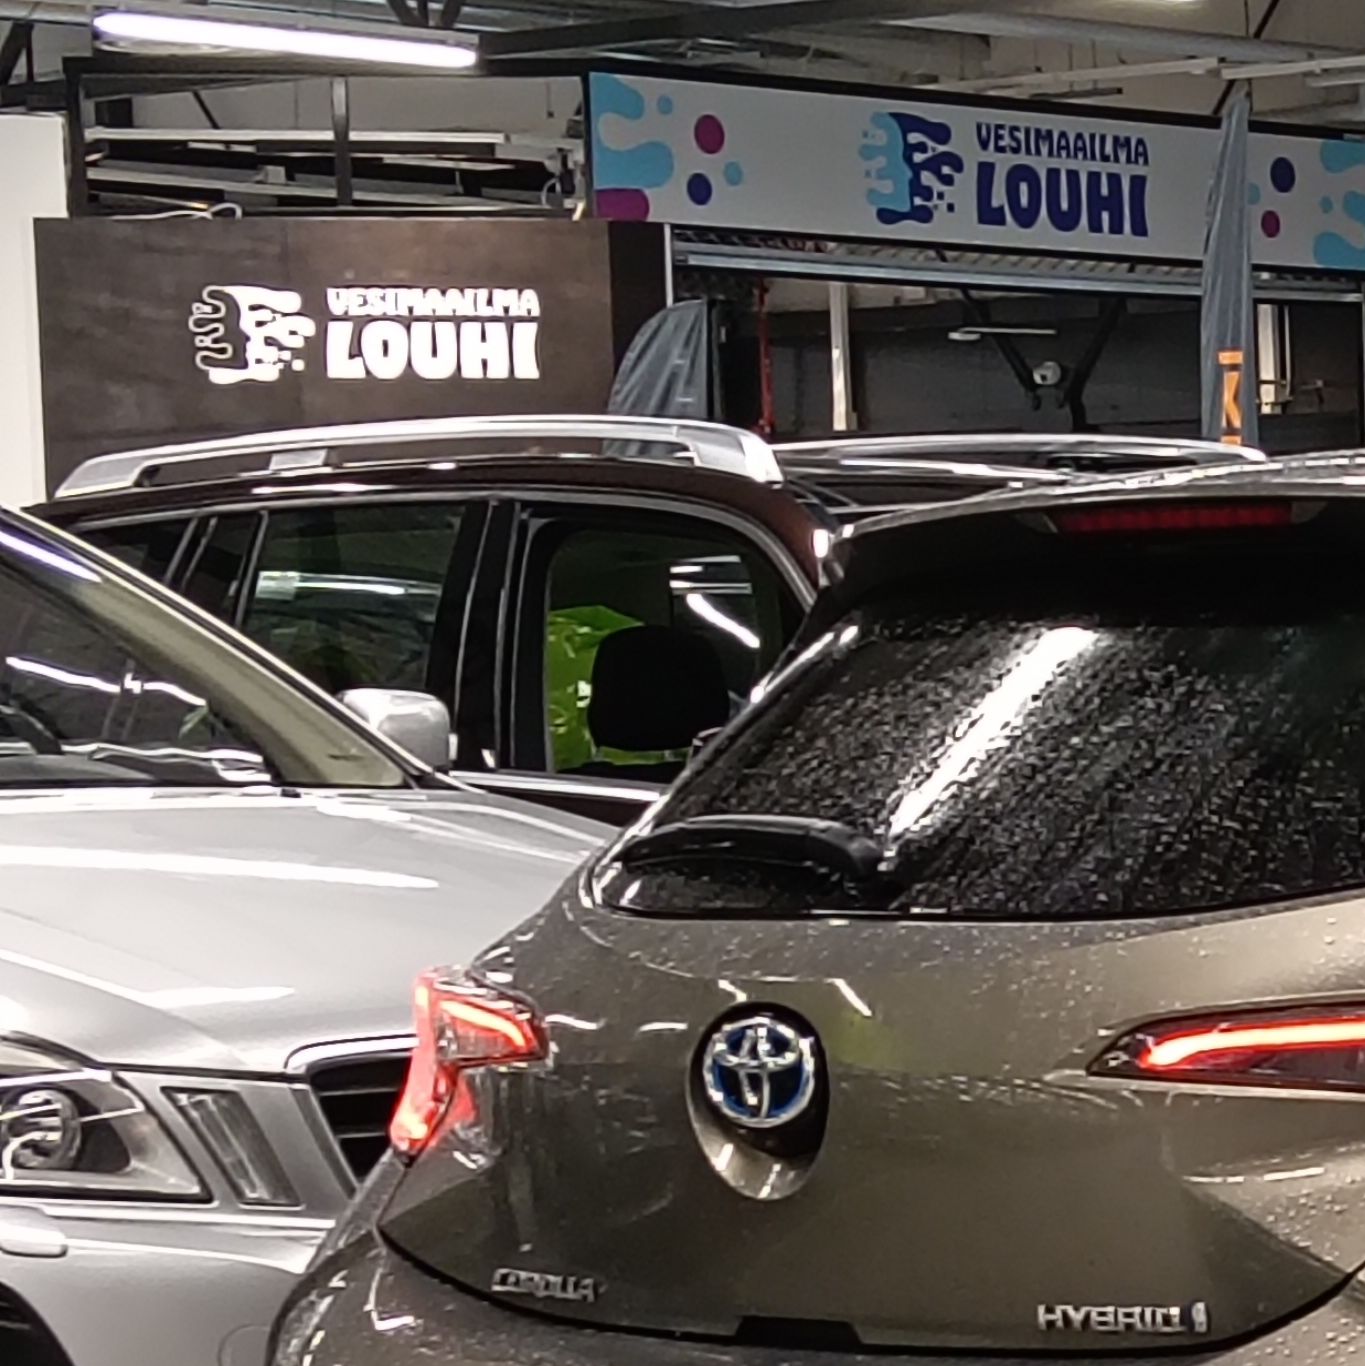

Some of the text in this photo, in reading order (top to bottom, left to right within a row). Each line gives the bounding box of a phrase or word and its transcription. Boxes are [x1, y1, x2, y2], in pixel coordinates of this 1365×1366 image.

[976, 121, 1149, 166] VESIMAAILMA
[976, 160, 1149, 237] LOUHI
[326, 286, 541, 316] VESIMAAILMA
[326, 320, 540, 379] LOUHI
[1036, 1303, 1188, 1333] HYBRID
